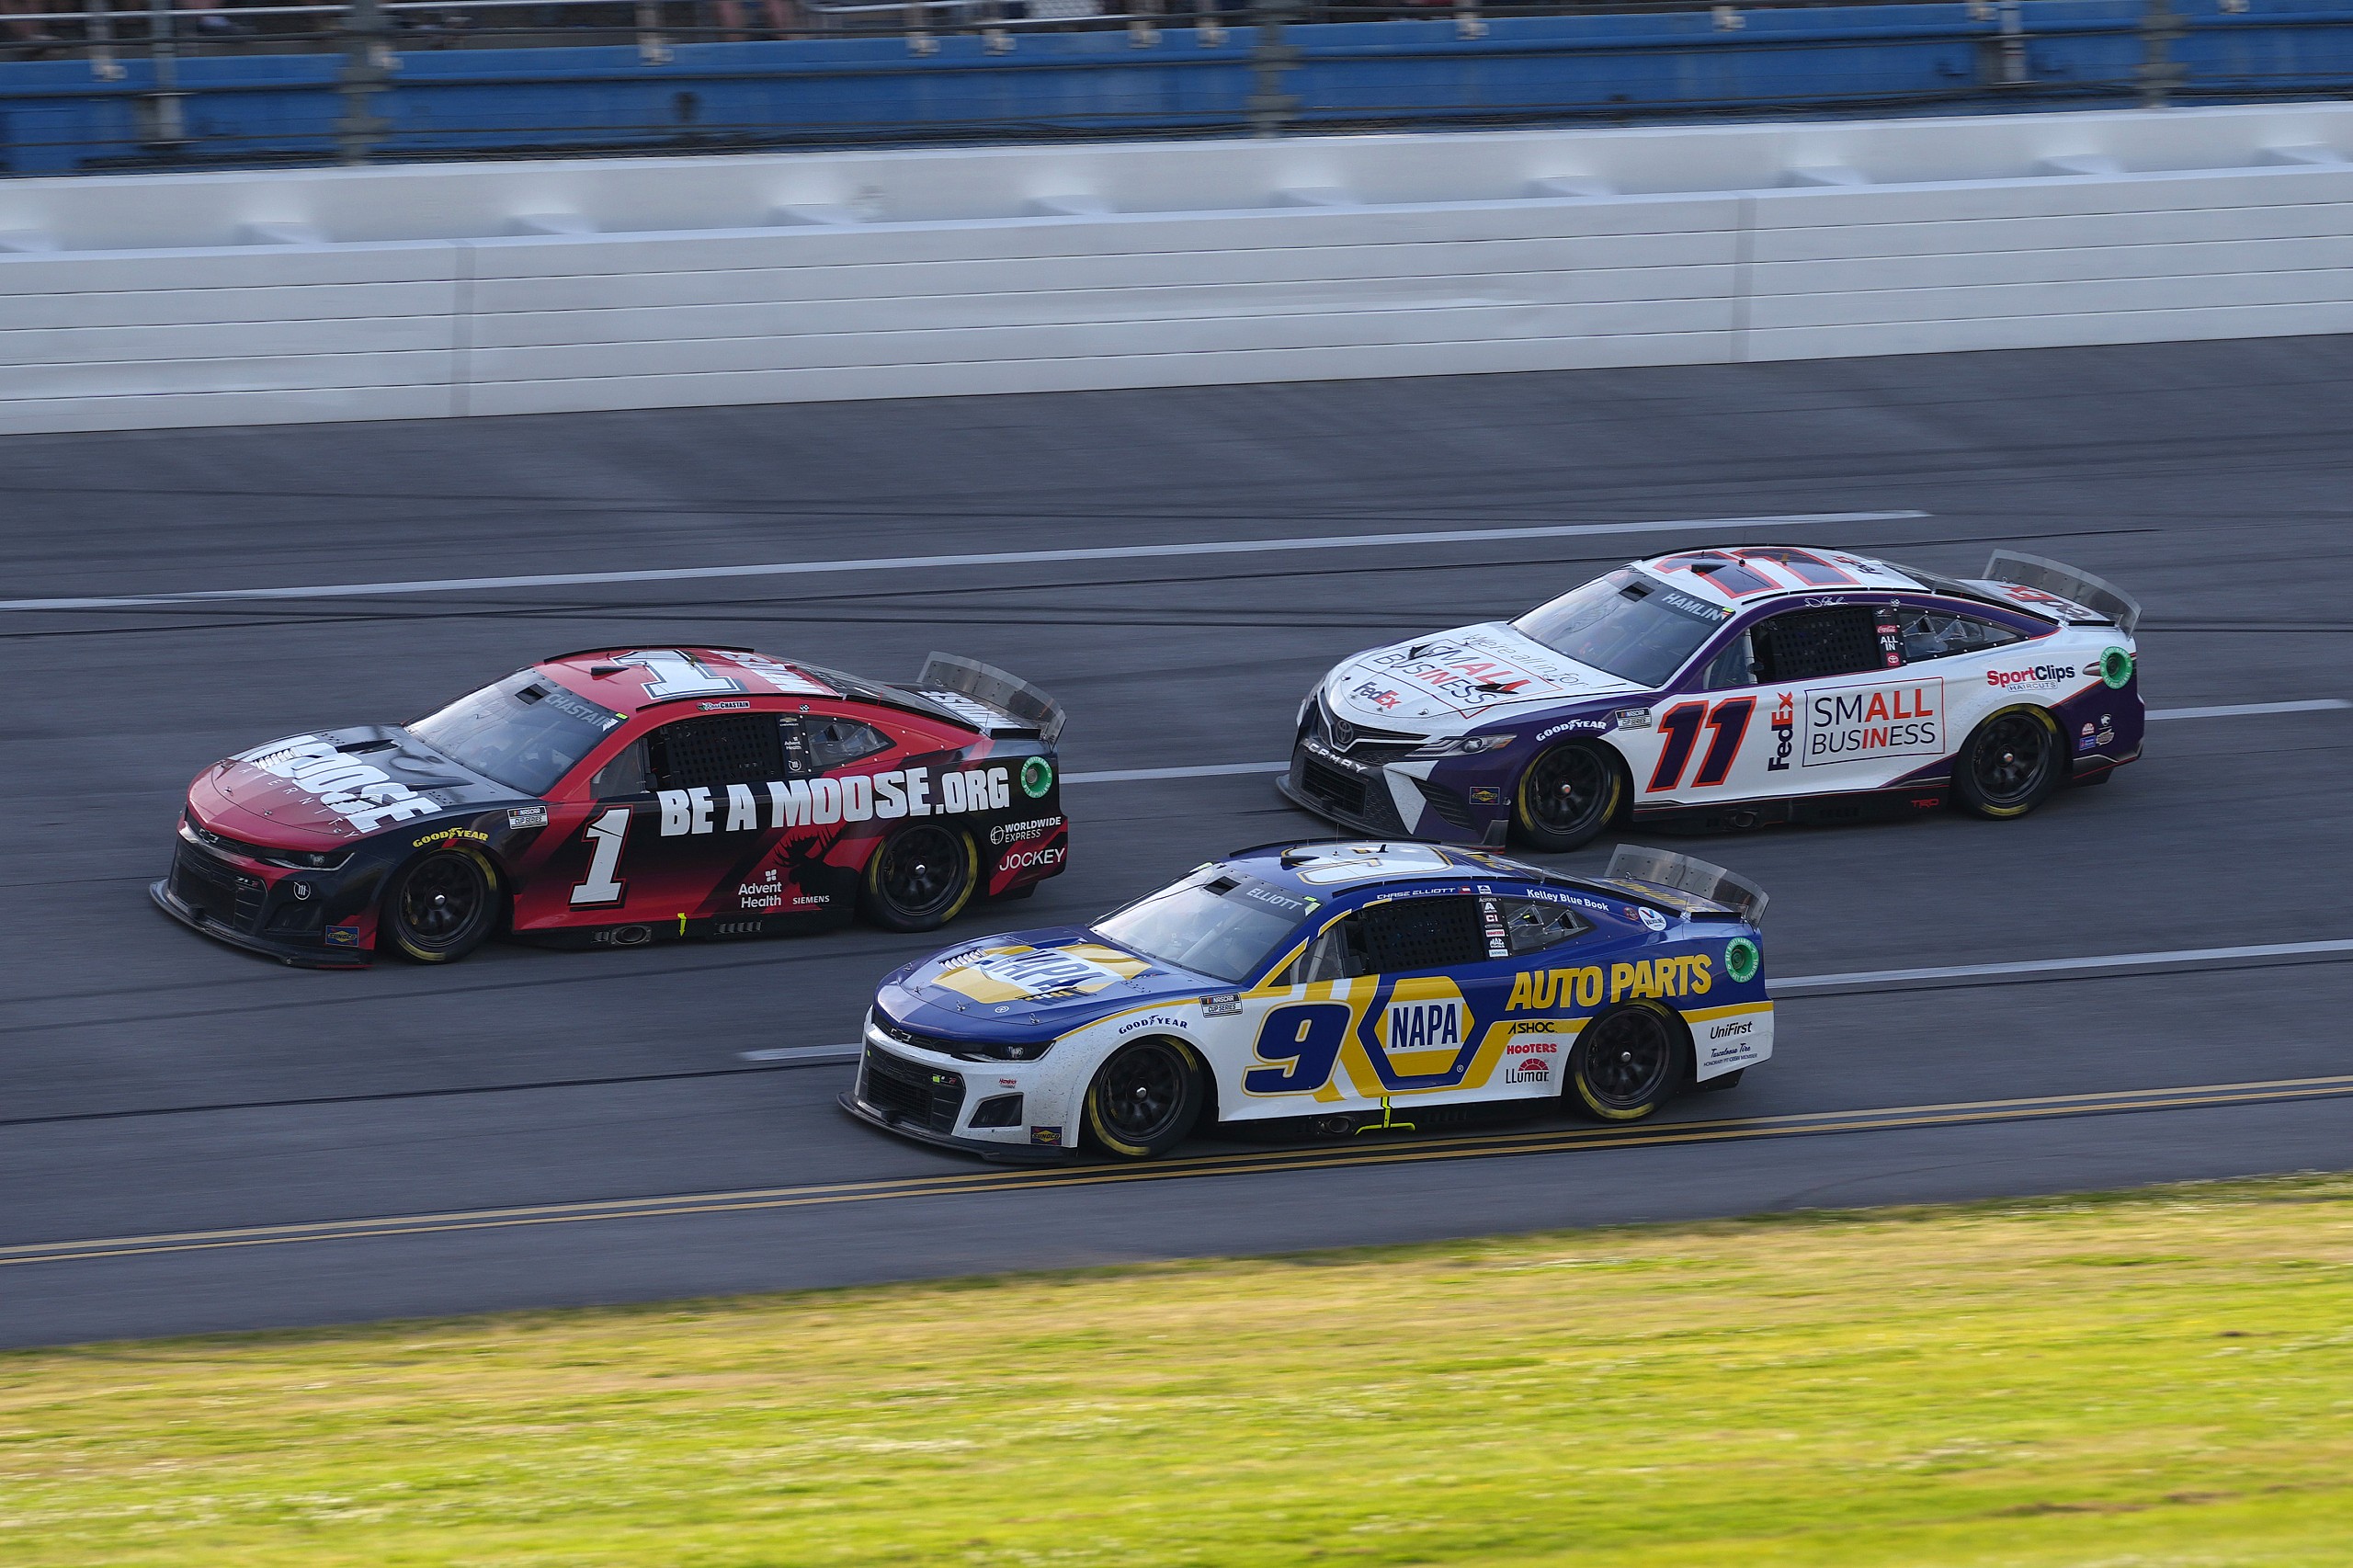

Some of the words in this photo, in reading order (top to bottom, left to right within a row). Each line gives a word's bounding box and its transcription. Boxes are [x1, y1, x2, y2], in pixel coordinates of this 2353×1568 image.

[1661, 593, 1723, 621] HAMLIN
[1881, 636, 1899, 644] ALL
[609, 649, 741, 700] 1
[1987, 665, 2075, 687] SportClips
[1352, 681, 1403, 710] FedEx
[2009, 682, 2057, 691] HAIRCUTS
[1813, 688, 1934, 728] SMALL
[1535, 719, 1607, 742] GOODYEAR
[1768, 691, 1794, 772] FedEx
[1812, 722, 1936, 756] BUSINESS
[1645, 696, 1757, 793] 11
[656, 786, 713, 836] BE
[725, 783, 757, 832] A
[767, 767, 1011, 828] MOOSE.ORG
[1005, 816, 1062, 834] WORLDWIDE
[1005, 828, 1041, 843] EXPRESS
[412, 827, 489, 847] GOODYEAR
[568, 806, 632, 906] 1
[999, 847, 1065, 871] JOCKEY
[738, 882, 782, 895] Advent
[792, 895, 830, 904] SIEMENS
[1245, 888, 1303, 910] ELLIOTT
[1377, 891, 1411, 900] CHASE
[1412, 887, 1456, 896] ELLIOTT
[741, 894, 782, 908] Health
[1527, 889, 1558, 903] Kelley
[1559, 893, 1583, 905] Blue
[1584, 898, 1609, 911] Book
[1505, 966, 1604, 1012] AUTO
[1610, 953, 1713, 1004] PARTS
[1119, 1015, 1188, 1035] GOODYEAR
[1391, 1003, 1459, 1049] NAPA
[1710, 1021, 1753, 1040] UniFirst
[1241, 1000, 1354, 1097] 9
[1506, 1043, 1558, 1054] HOOTERS
[1506, 1068, 1550, 1084] LLumar
